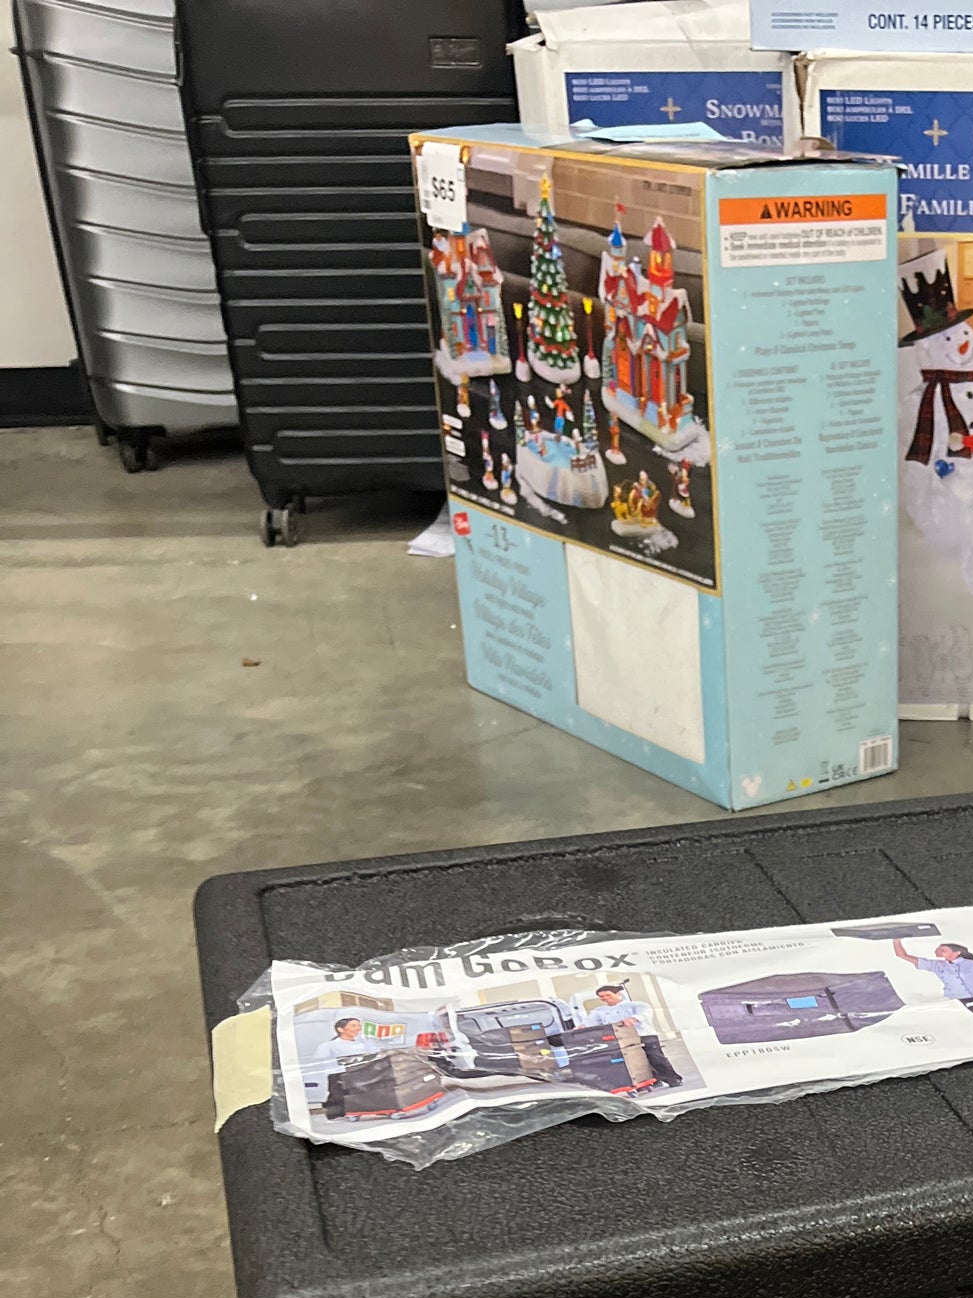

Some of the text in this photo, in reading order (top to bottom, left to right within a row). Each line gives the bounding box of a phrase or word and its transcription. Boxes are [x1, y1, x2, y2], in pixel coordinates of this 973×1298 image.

[868, 13, 908, 30] CONT.
[914, 14, 928, 29] 14
[901, 164, 970, 180] MILLE
[431, 176, 456, 202] $65
[774, 200, 853, 219] WARNING
[646, 944, 698, 956] INSULATED
